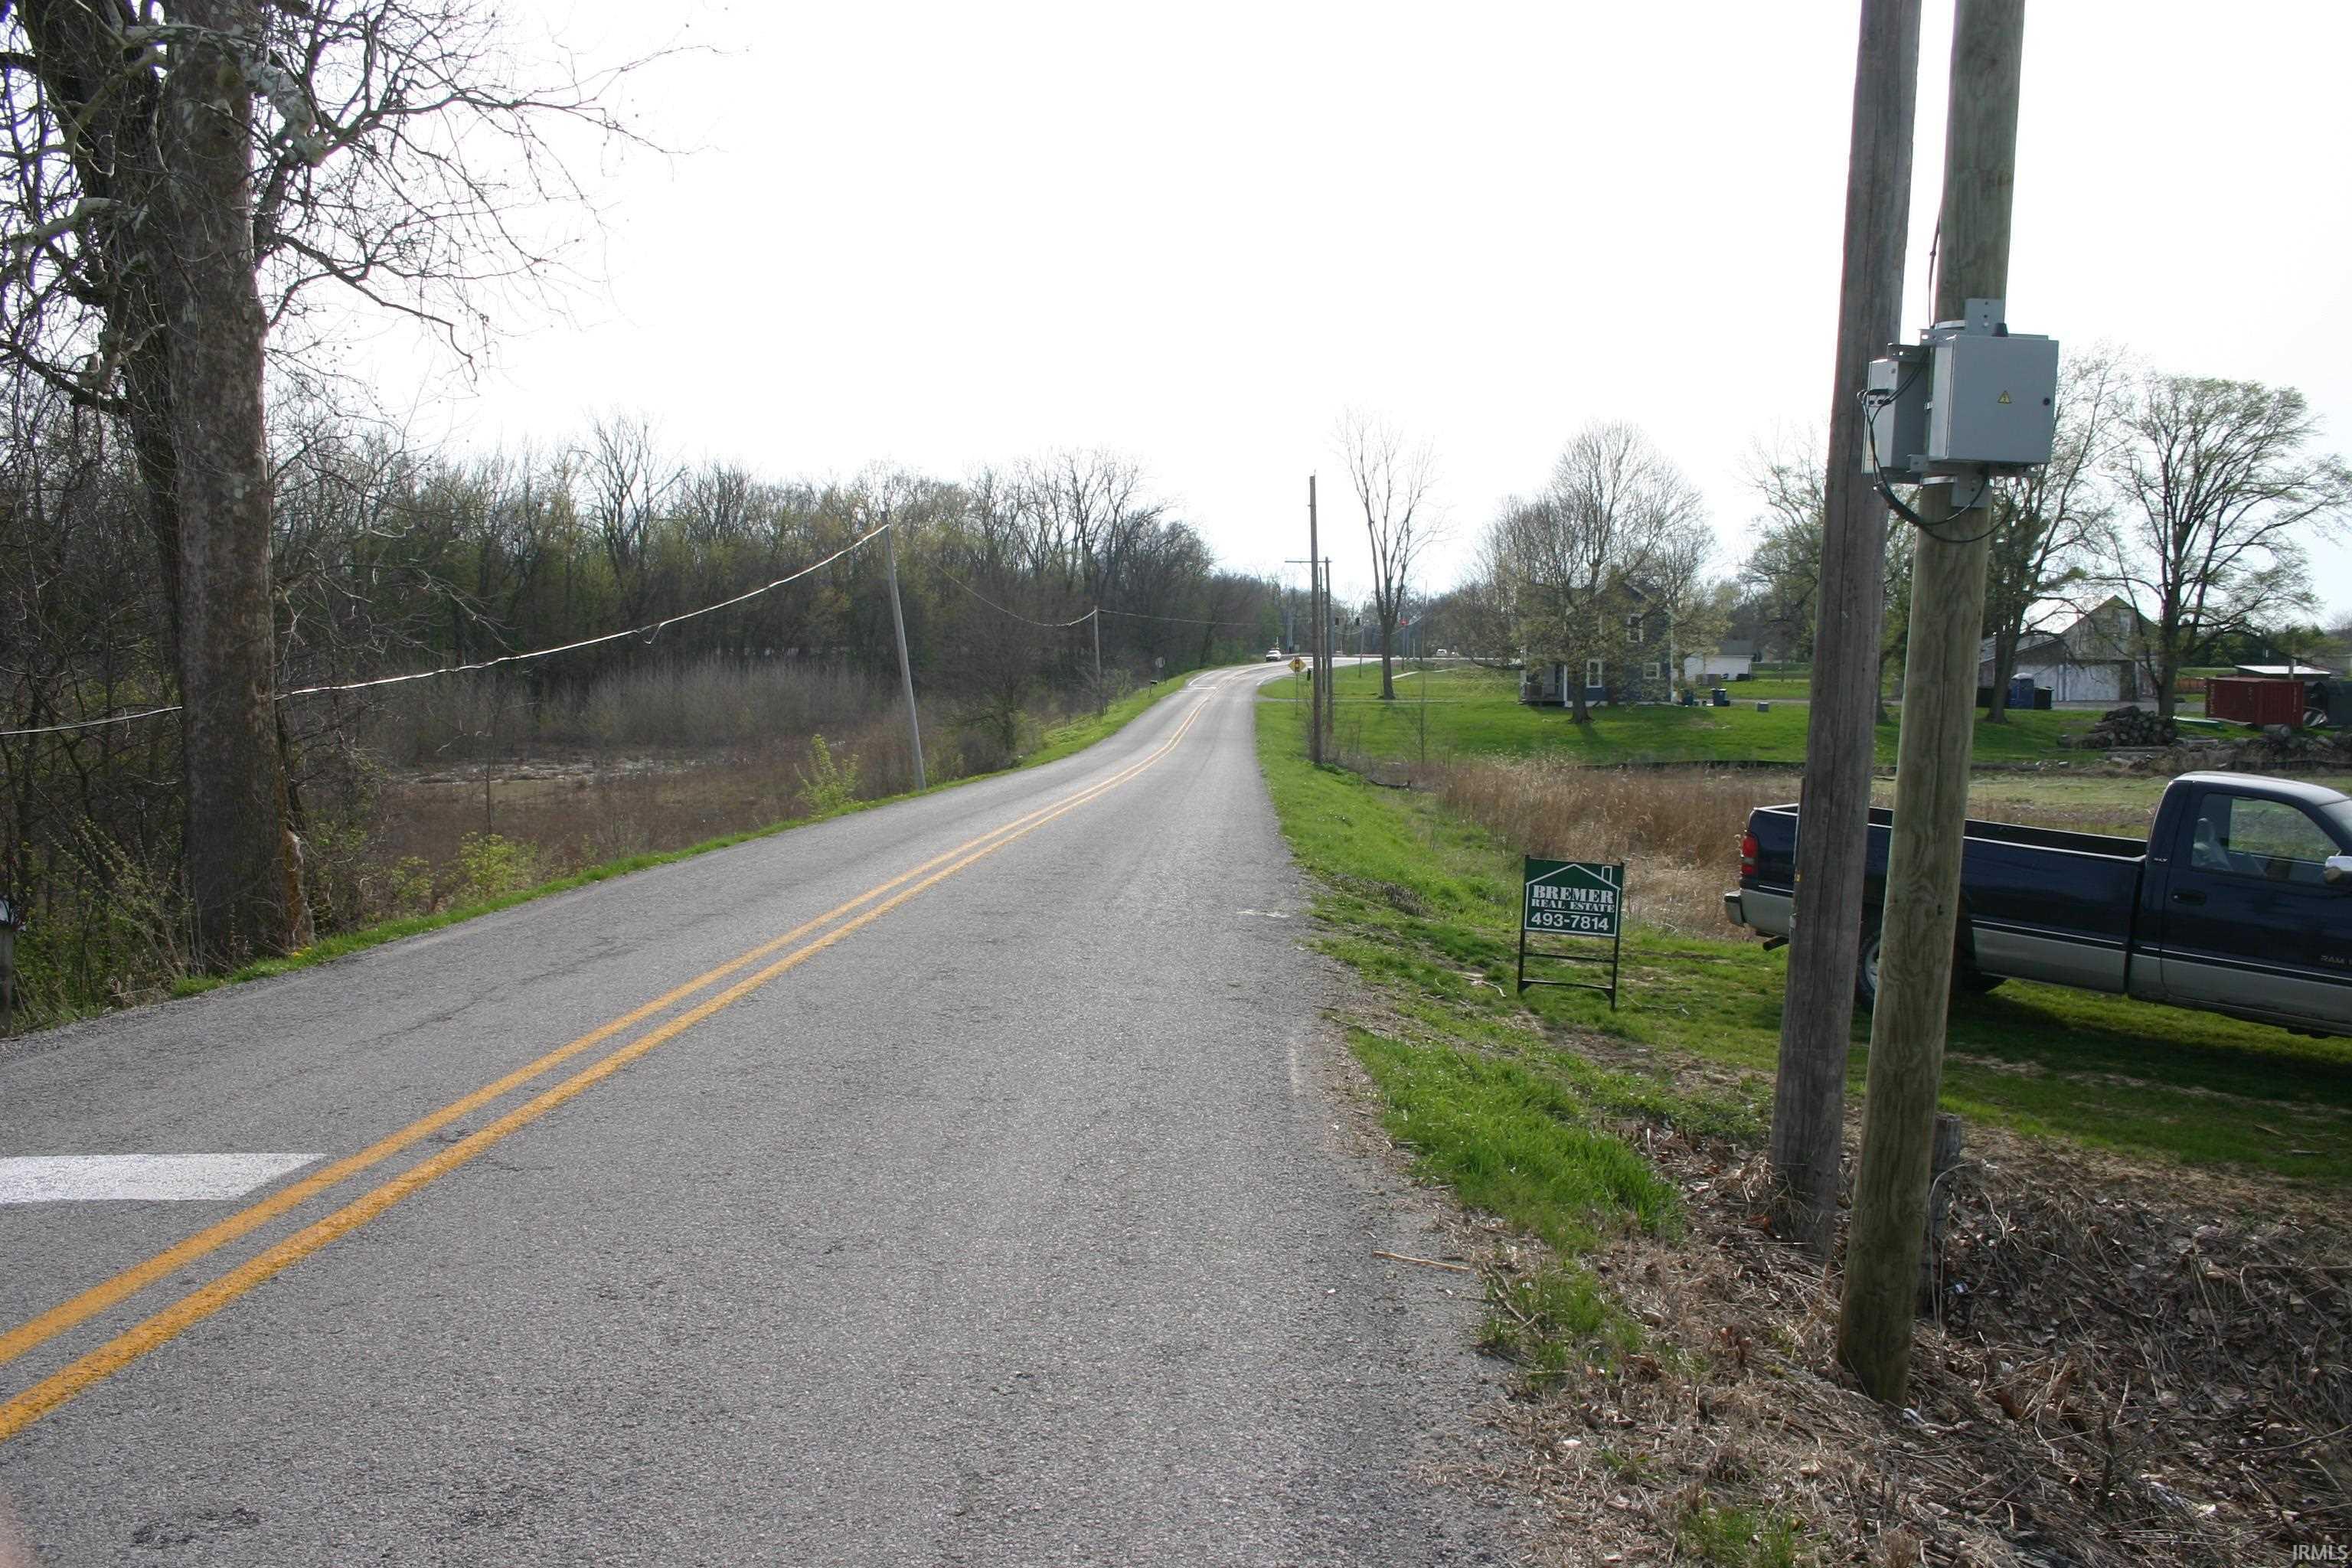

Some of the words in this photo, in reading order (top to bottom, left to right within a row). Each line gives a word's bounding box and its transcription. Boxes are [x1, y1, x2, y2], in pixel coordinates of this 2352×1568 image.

[1533, 884, 1614, 903] BREMER
[1531, 898, 1565, 909] REAL
[1570, 901, 1615, 913] ESTATE
[1531, 912, 1609, 930] 493-7814
